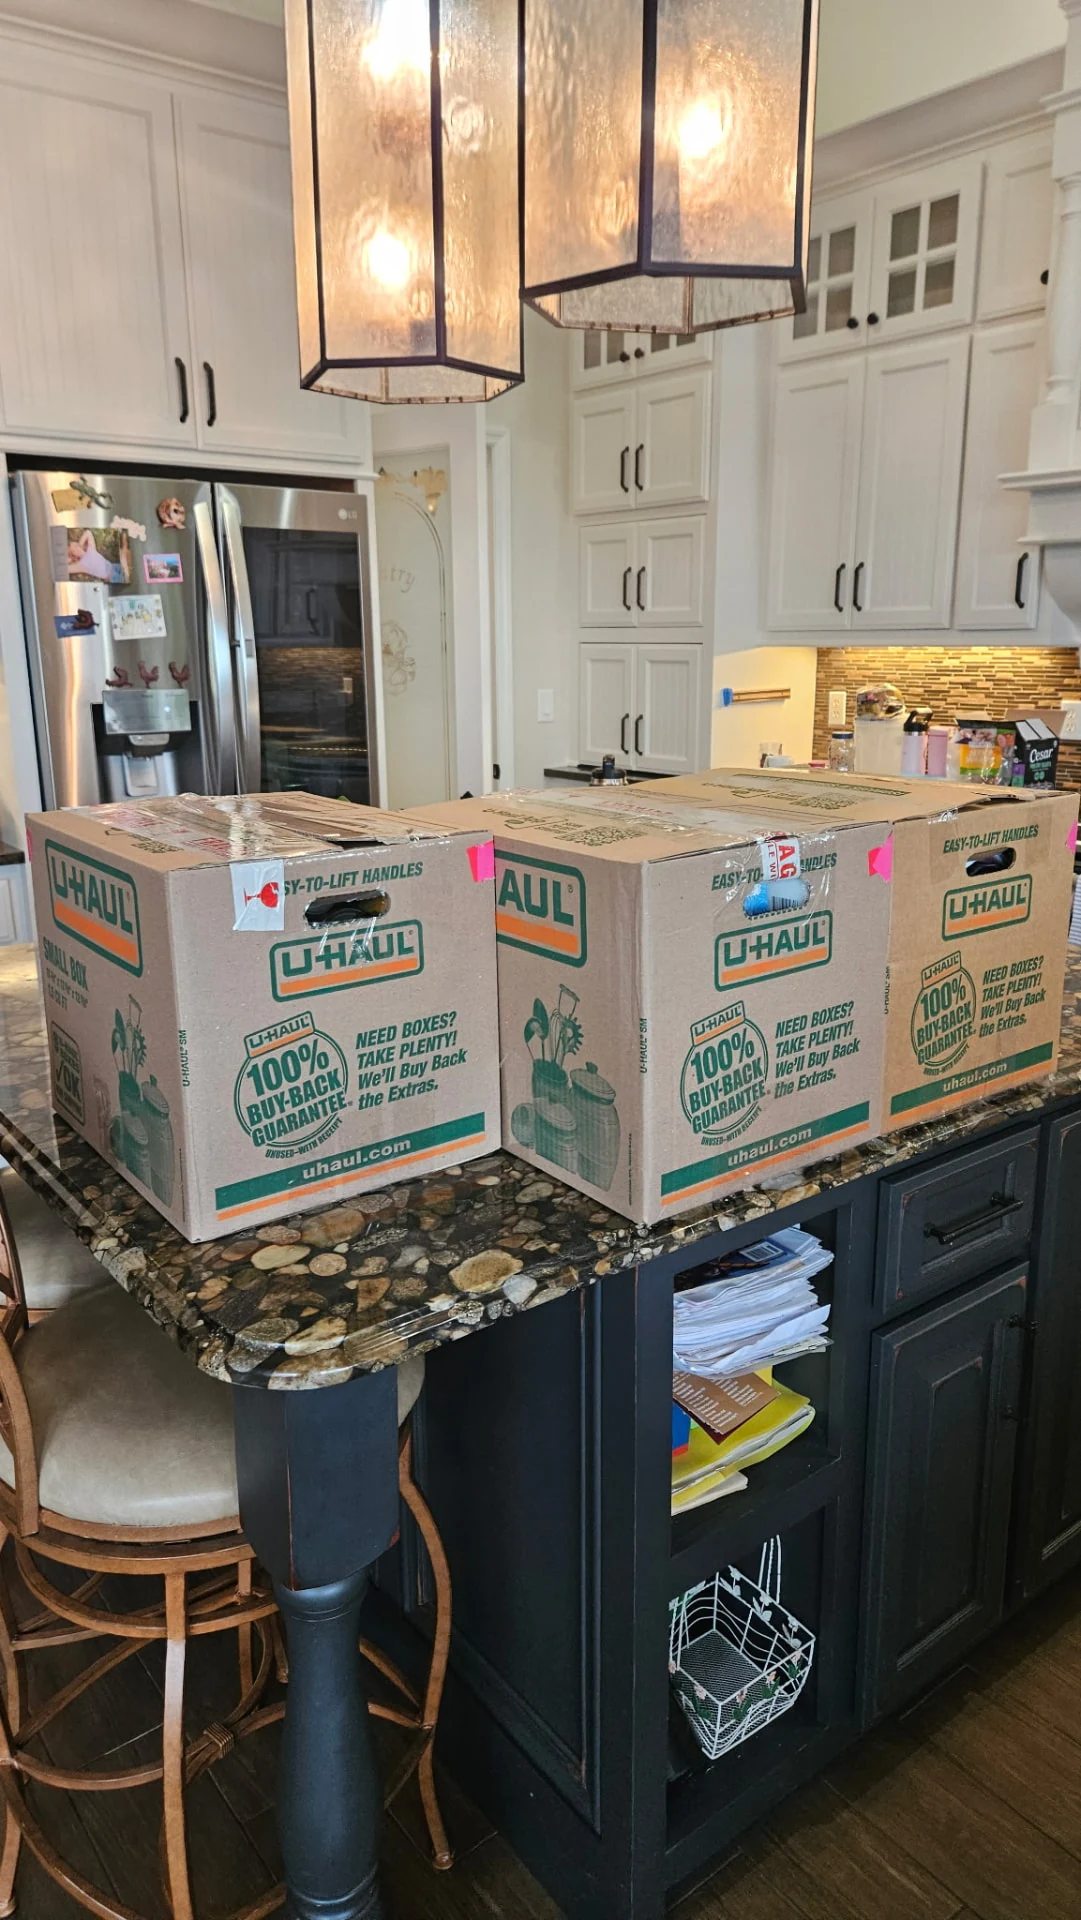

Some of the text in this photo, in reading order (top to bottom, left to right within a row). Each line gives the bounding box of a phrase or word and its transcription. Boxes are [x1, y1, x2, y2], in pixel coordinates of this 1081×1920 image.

[1030, 748, 1054, 763] Cesar
[943, 824, 1039, 854] EASY-TO-LIFT HANDLES
[284, 861, 424, 896] SY-TO-LIFT HANDLES
[711, 853, 838, 891] EASY-TO- ANDLES
[498, 868, 574, 927] AUL
[69, 956, 88, 991] BOX
[982, 955, 1044, 985] NEED BOXES?
[982, 972, 1042, 1003] TAKE PLENTY!
[919, 973, 966, 1022] 100%
[980, 988, 1047, 1020] We'll Buy Back
[178, 1029, 187, 1046] SM
[355, 1011, 457, 1050] NEED BOXES?
[639, 1017, 648, 1033] SM
[775, 1000, 855, 1039] NEED BOXES?
[916, 1001, 972, 1048] BUY-BACK
[978, 1013, 1027, 1038] the Extras.
[357, 1030, 458, 1070] TAKE PLENTY!
[690, 1028, 755, 1085] 100%
[775, 1037, 861, 1079] We'll Buy Back
[776, 1020, 854, 1059] TAKE PLENTY!
[247, 1038, 329, 1097] 100%
[358, 1048, 467, 1091] We'll Buy Back
[688, 1057, 764, 1114] BUY-BACK
[774, 1068, 837, 1099] the Extras.
[943, 1063, 1008, 1092] uhaul.com
[246, 1068, 342, 1127] BUY-BACK
[358, 1078, 438, 1111] the Extras.
[318, 1117, 343, 1145] RECEIPT
[728, 1128, 812, 1167] uhaul.com
[302, 1138, 411, 1180] uhaul.com
